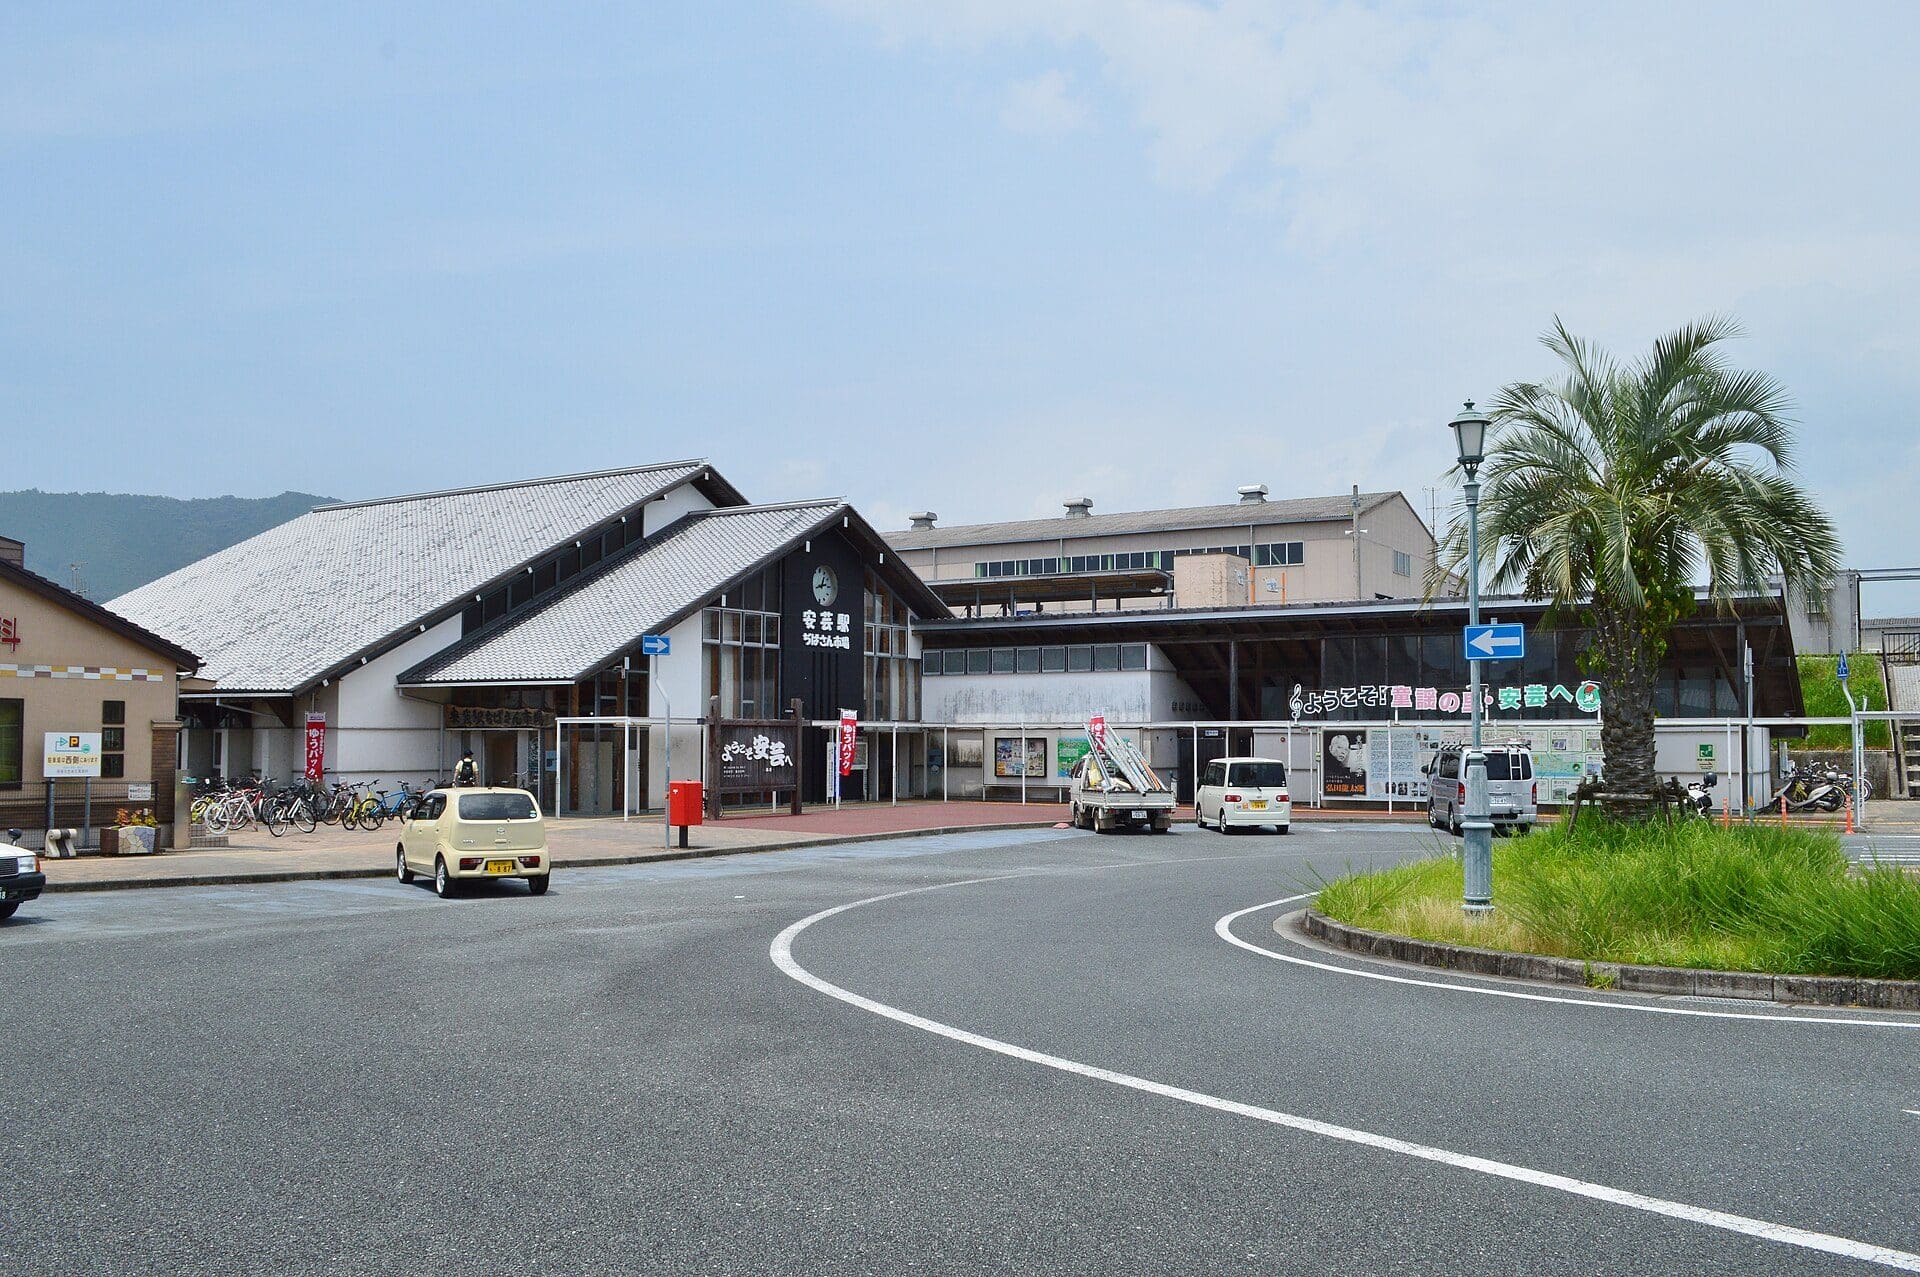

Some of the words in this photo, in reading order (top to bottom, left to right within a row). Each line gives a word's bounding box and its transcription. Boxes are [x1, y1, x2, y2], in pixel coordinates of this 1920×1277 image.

[802, 609, 850, 633] 安芸駅
[308, 728, 320, 776] ゆうパック
[721, 734, 793, 767] ようこそ安芸へ
[842, 724, 853, 769] ゆうパック
